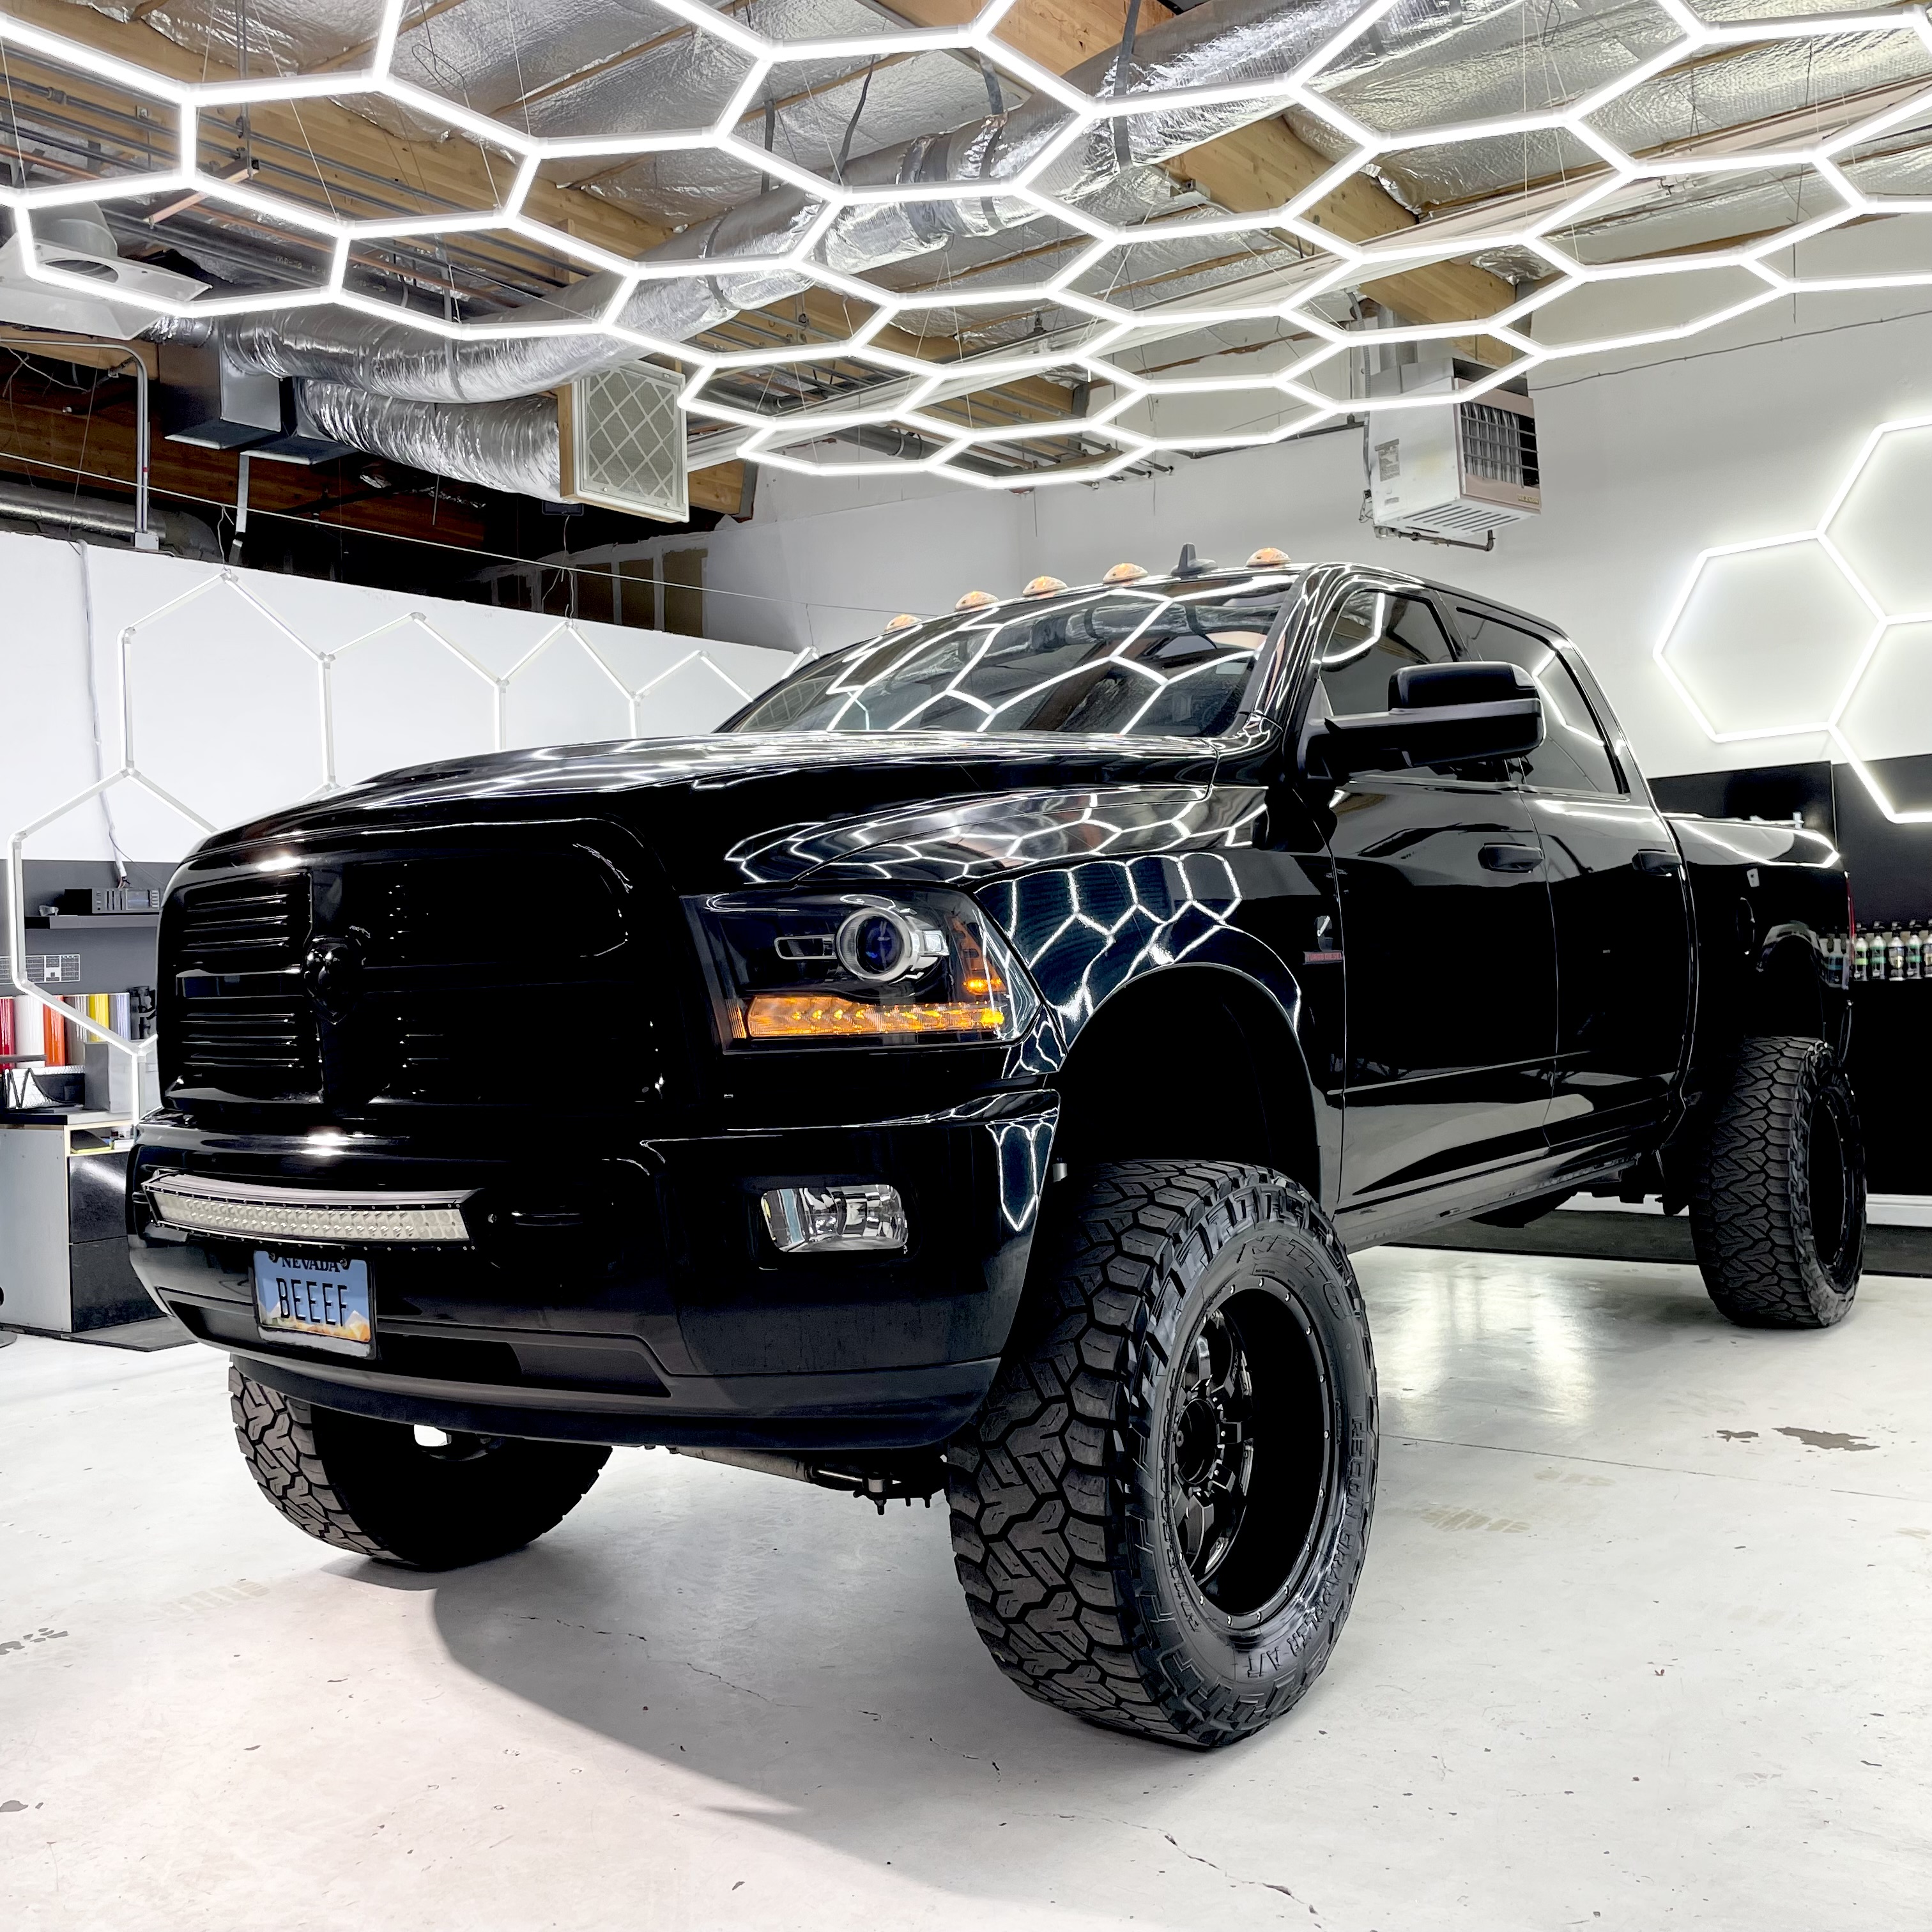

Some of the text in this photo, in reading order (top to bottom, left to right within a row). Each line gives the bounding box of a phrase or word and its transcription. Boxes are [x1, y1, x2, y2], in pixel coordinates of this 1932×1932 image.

[282, 1257, 341, 1273] NEVADA
[1235, 1233, 1347, 1321] NITTO
[276, 1277, 348, 1327] BEEEF
[1345, 1416, 1365, 1520] RECON
